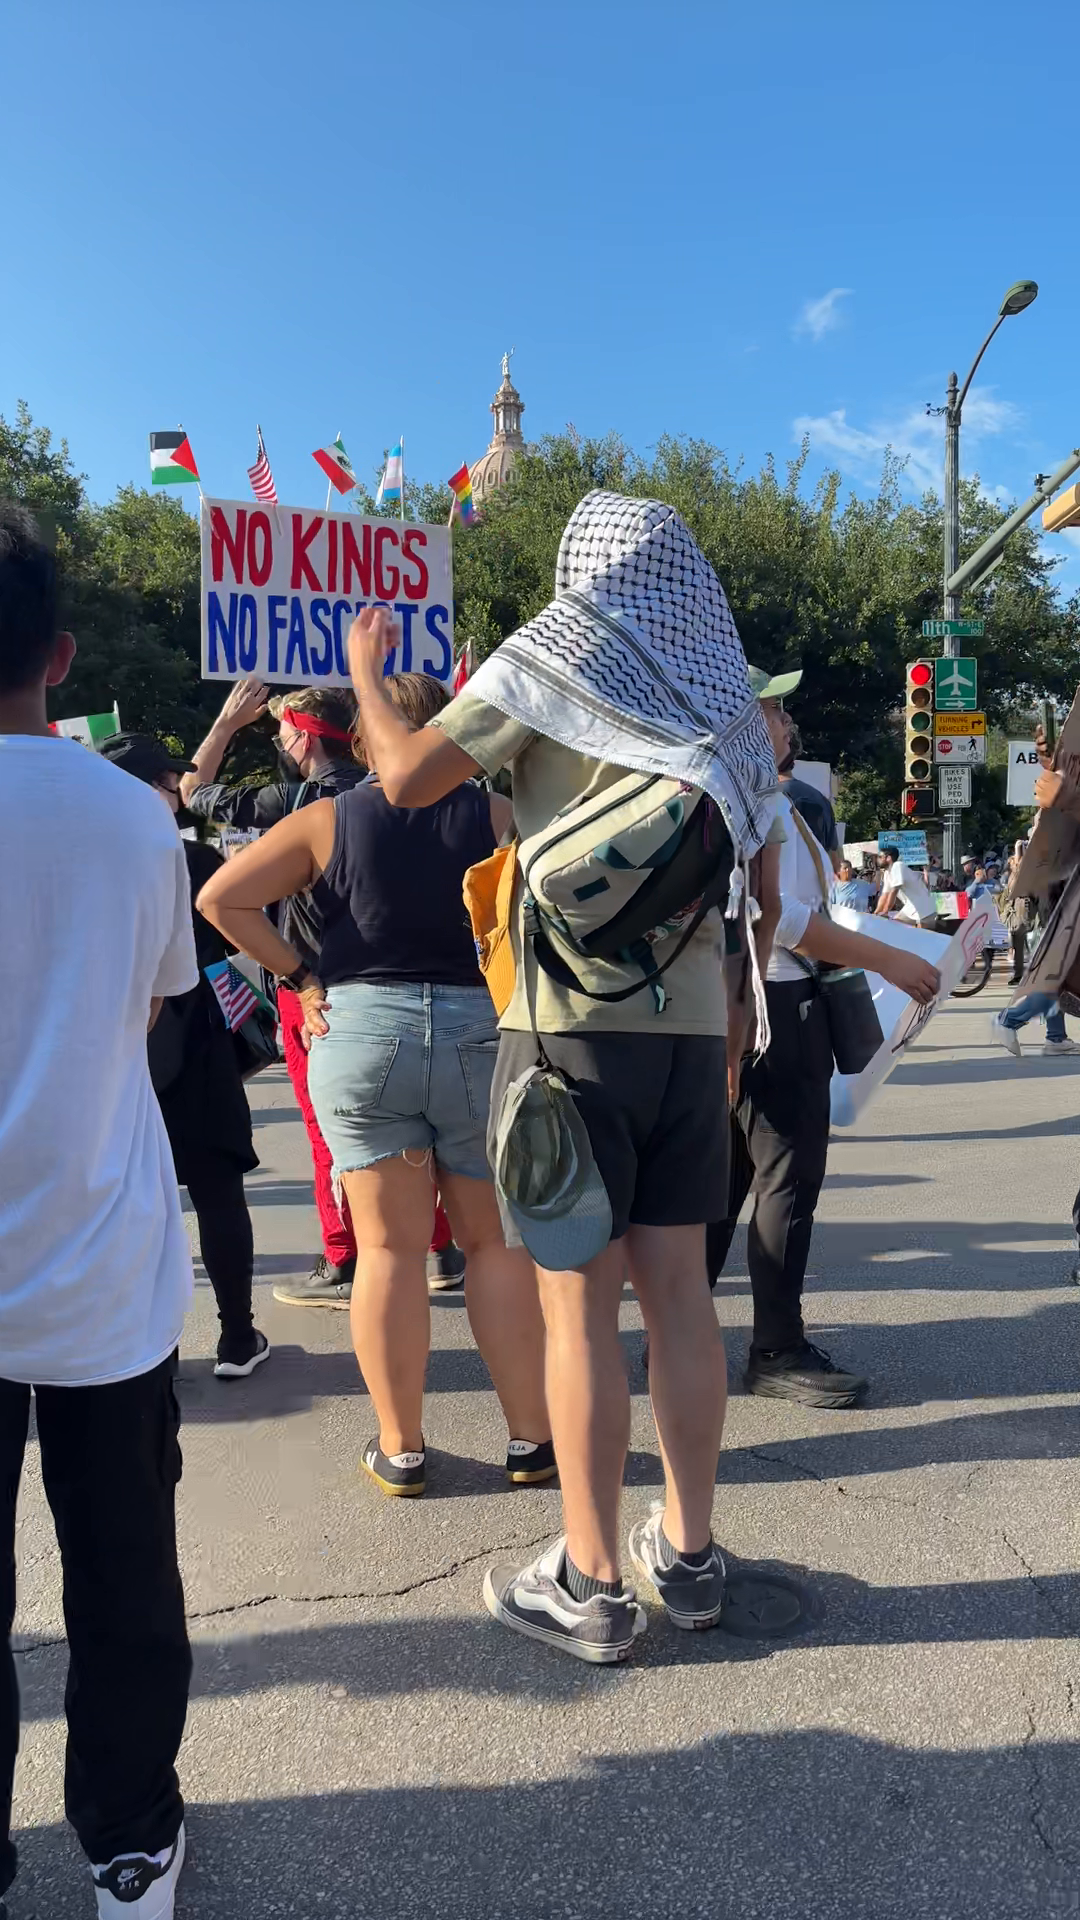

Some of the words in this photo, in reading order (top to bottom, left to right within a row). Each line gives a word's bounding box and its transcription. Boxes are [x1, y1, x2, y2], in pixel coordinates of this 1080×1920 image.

[211, 506, 273, 586] NO
[290, 513, 429, 600] KINGS
[924, 621, 950, 636] 11th
[208, 591, 257, 673] NO
[268, 595, 451, 681] FASCTS
[938, 725, 969, 733] VEHICLES
[400, 1456, 420, 1464] VEJA
[119, 1880, 140, 1890] AIR
